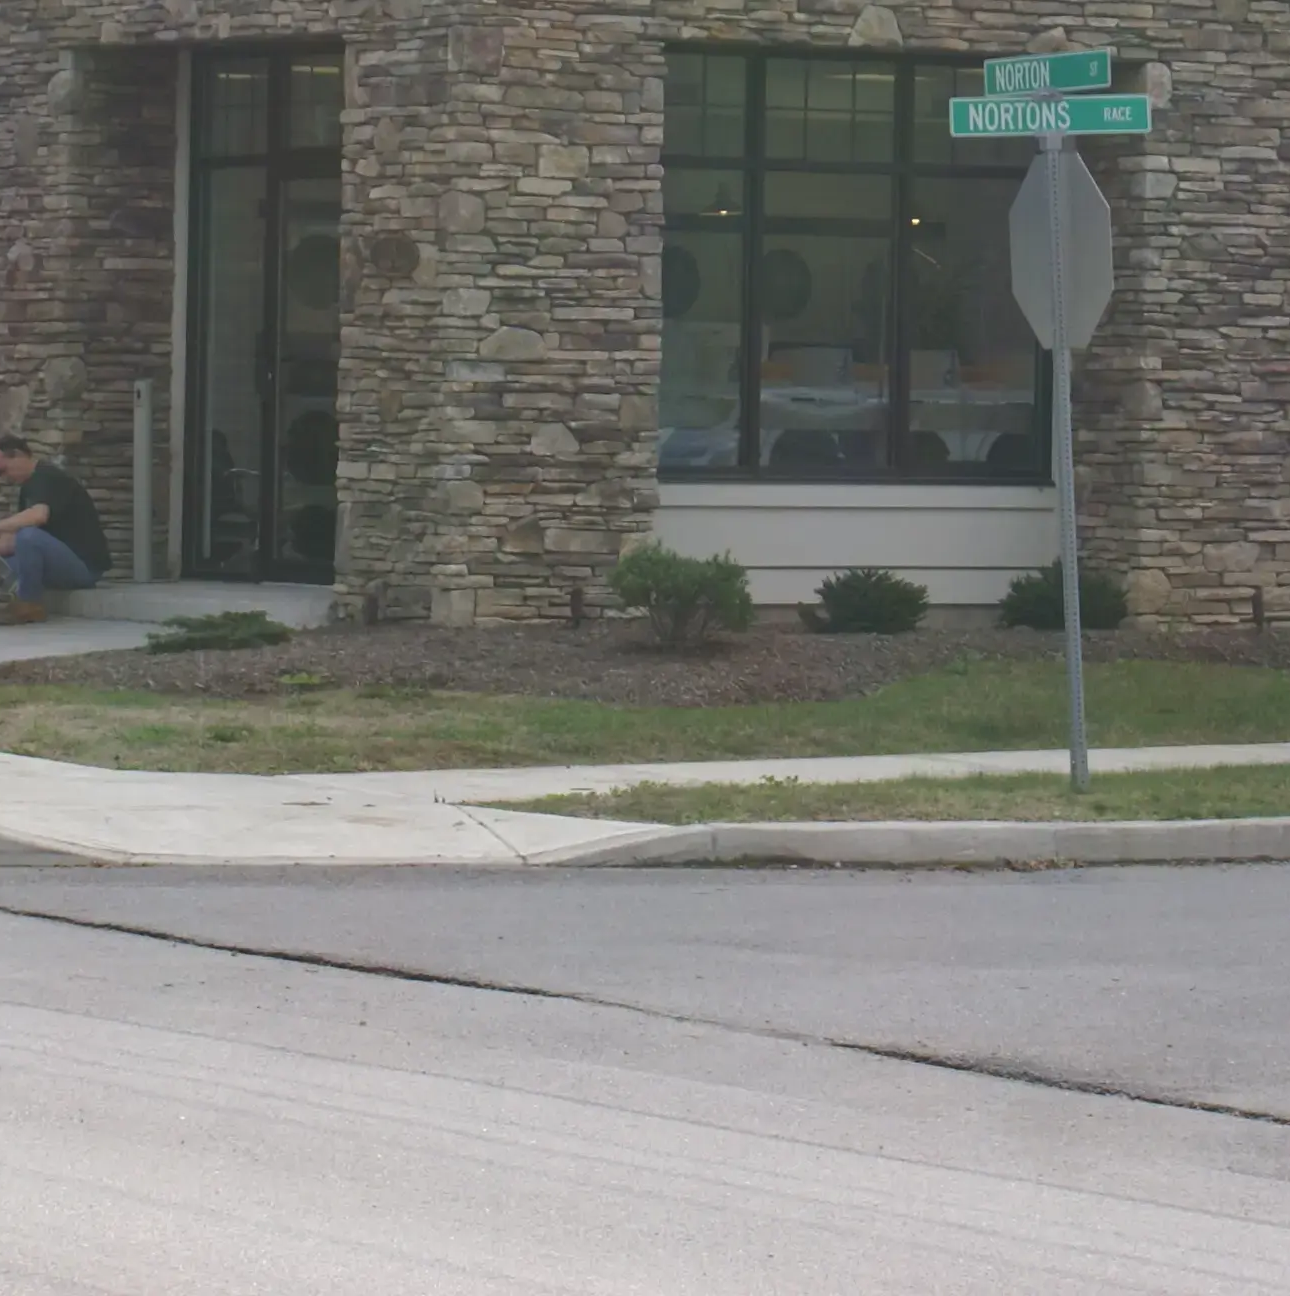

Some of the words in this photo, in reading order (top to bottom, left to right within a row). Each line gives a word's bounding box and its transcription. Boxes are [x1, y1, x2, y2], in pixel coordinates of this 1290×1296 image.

[995, 60, 1050, 92] NORTON
[1089, 61, 1099, 77] ST
[968, 101, 1071, 132] NORTONS
[1103, 106, 1133, 122] RACE
